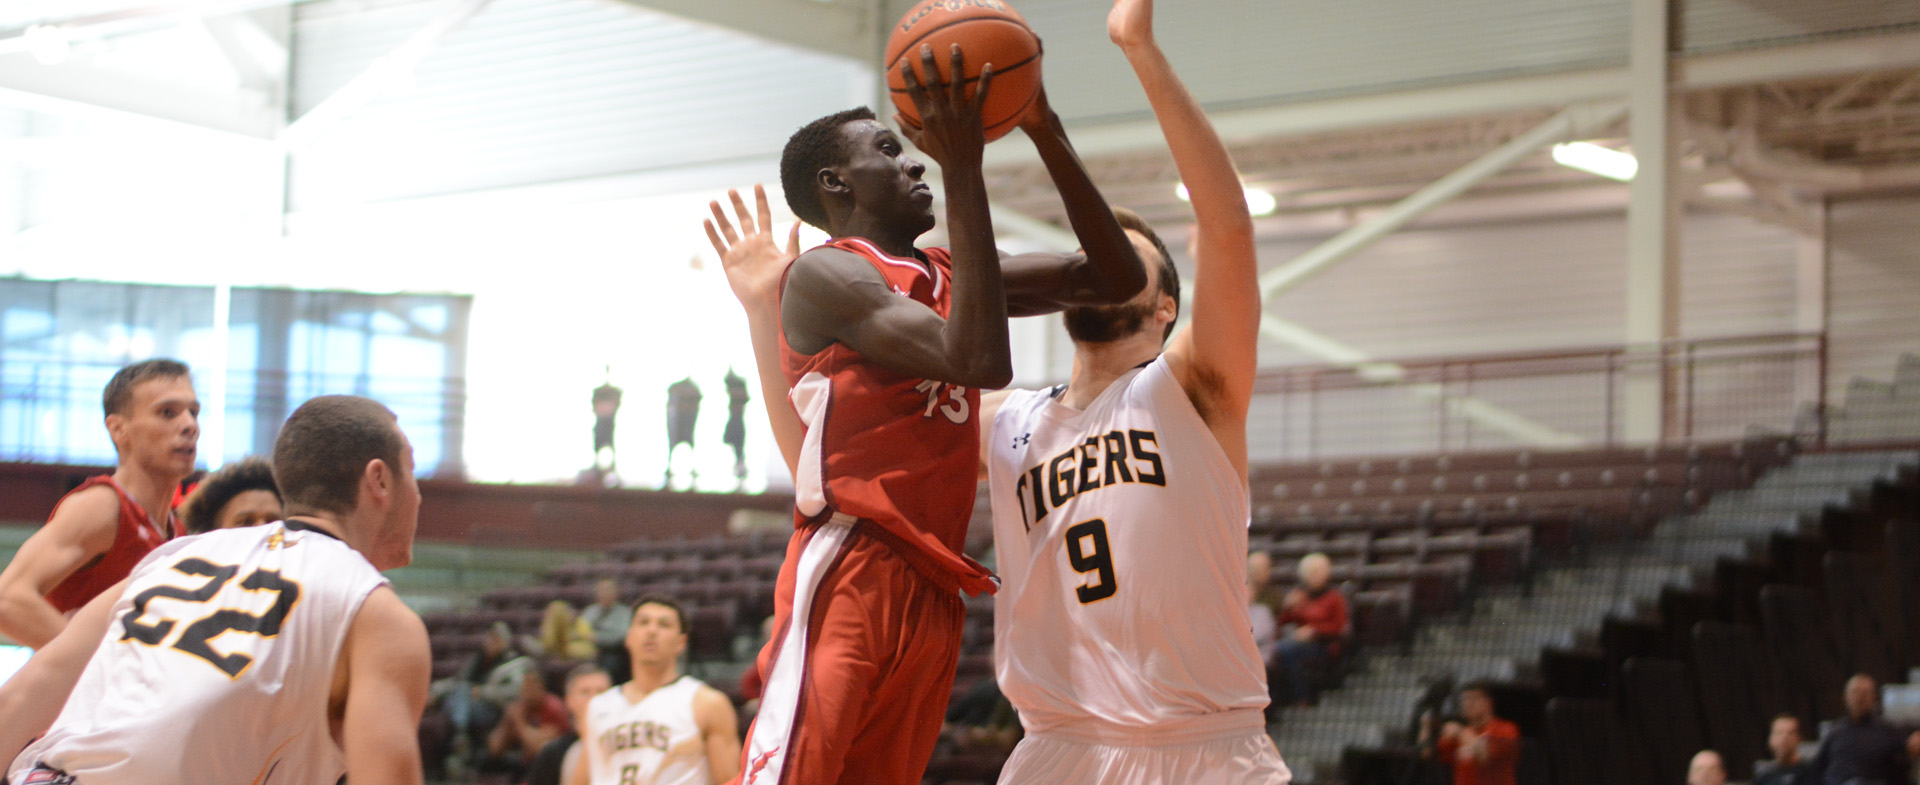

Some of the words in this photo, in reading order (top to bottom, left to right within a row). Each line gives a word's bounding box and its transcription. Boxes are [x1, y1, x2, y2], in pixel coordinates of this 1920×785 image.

[1016, 428, 1167, 533] TIGERS
[1065, 516, 1118, 605] 9
[118, 556, 303, 682] 22
